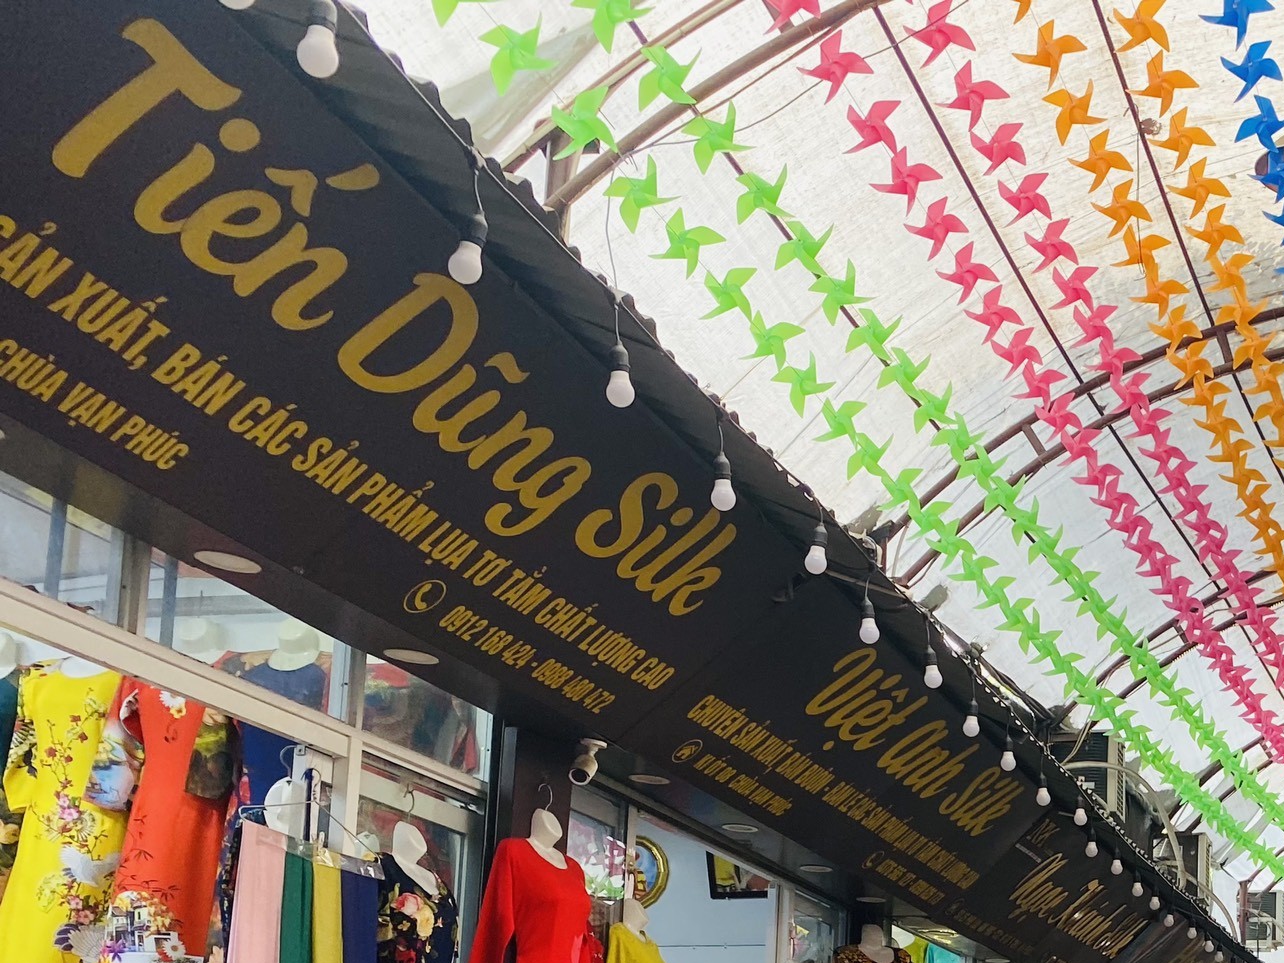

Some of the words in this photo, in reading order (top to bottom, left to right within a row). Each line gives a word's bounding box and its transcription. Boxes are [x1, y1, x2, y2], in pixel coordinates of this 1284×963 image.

[52, 18, 380, 331] Tiến
[337, 272, 592, 537] Dũng
[575, 472, 737, 616] Silk
[47, 272, 172, 371] XUẤT,
[151, 343, 246, 416] BÁN
[228, 397, 308, 455] CÁC
[292, 437, 368, 495] SẢN
[346, 472, 439, 542] PHẨM
[418, 521, 479, 570] LỤA
[462, 549, 513, 586] TƠ
[535, 598, 599, 642] CHẤT
[578, 625, 646, 673] LƯỢNG
[631, 657, 675, 690] CAO
[58, 382, 126, 433] VẠN
[110, 415, 189, 470] PHÚC
[439, 606, 489, 641] 0912
[474, 627, 514, 655] 168
[501, 641, 537, 669] 424
[583, 688, 615, 714] 472
[687, 695, 749, 739] CHUYÊN
[729, 720, 771, 753] SẢN
[775, 752, 812, 780] BÁN
[805, 647, 928, 750] Việt
[939, 766, 1024, 837] Silk
